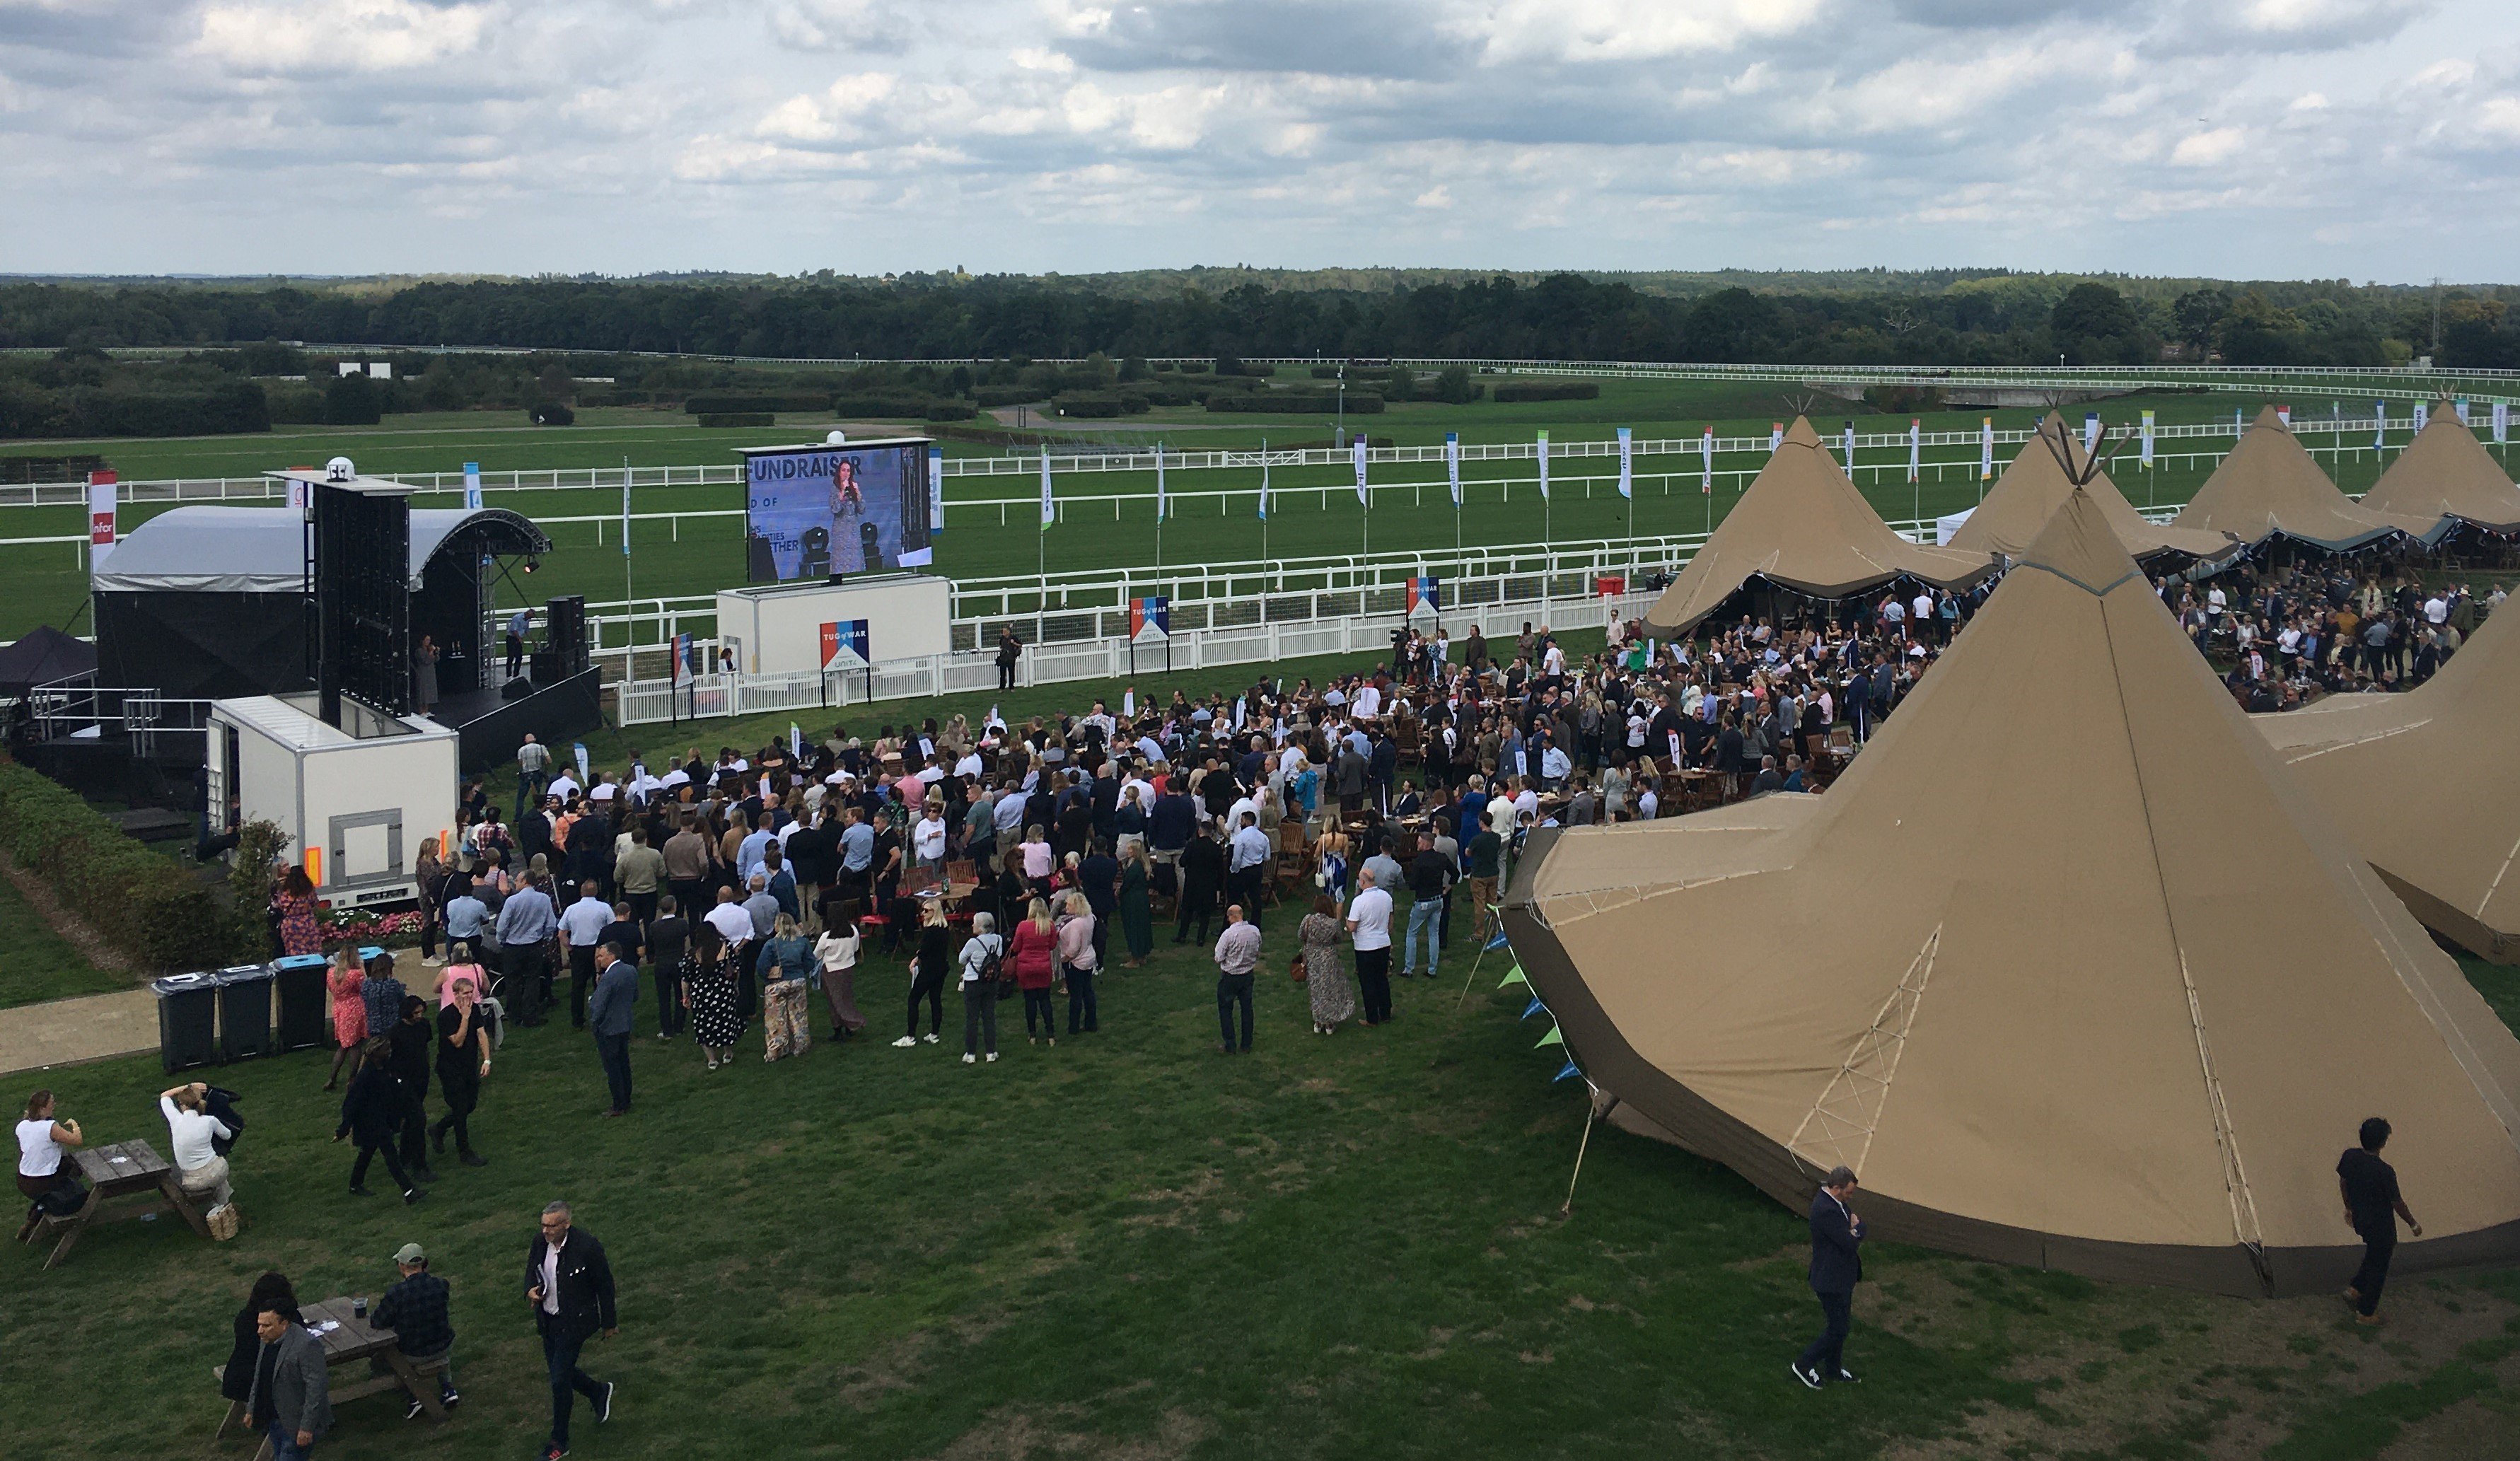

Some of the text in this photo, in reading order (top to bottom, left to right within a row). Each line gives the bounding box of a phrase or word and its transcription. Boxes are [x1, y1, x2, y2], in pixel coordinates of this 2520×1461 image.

[749, 455, 862, 481] FUNDRAISR
[763, 497, 777, 507] OF
[93, 521, 112, 533] nfor
[770, 540, 799, 552] THER
[823, 632, 840, 641] TUG
